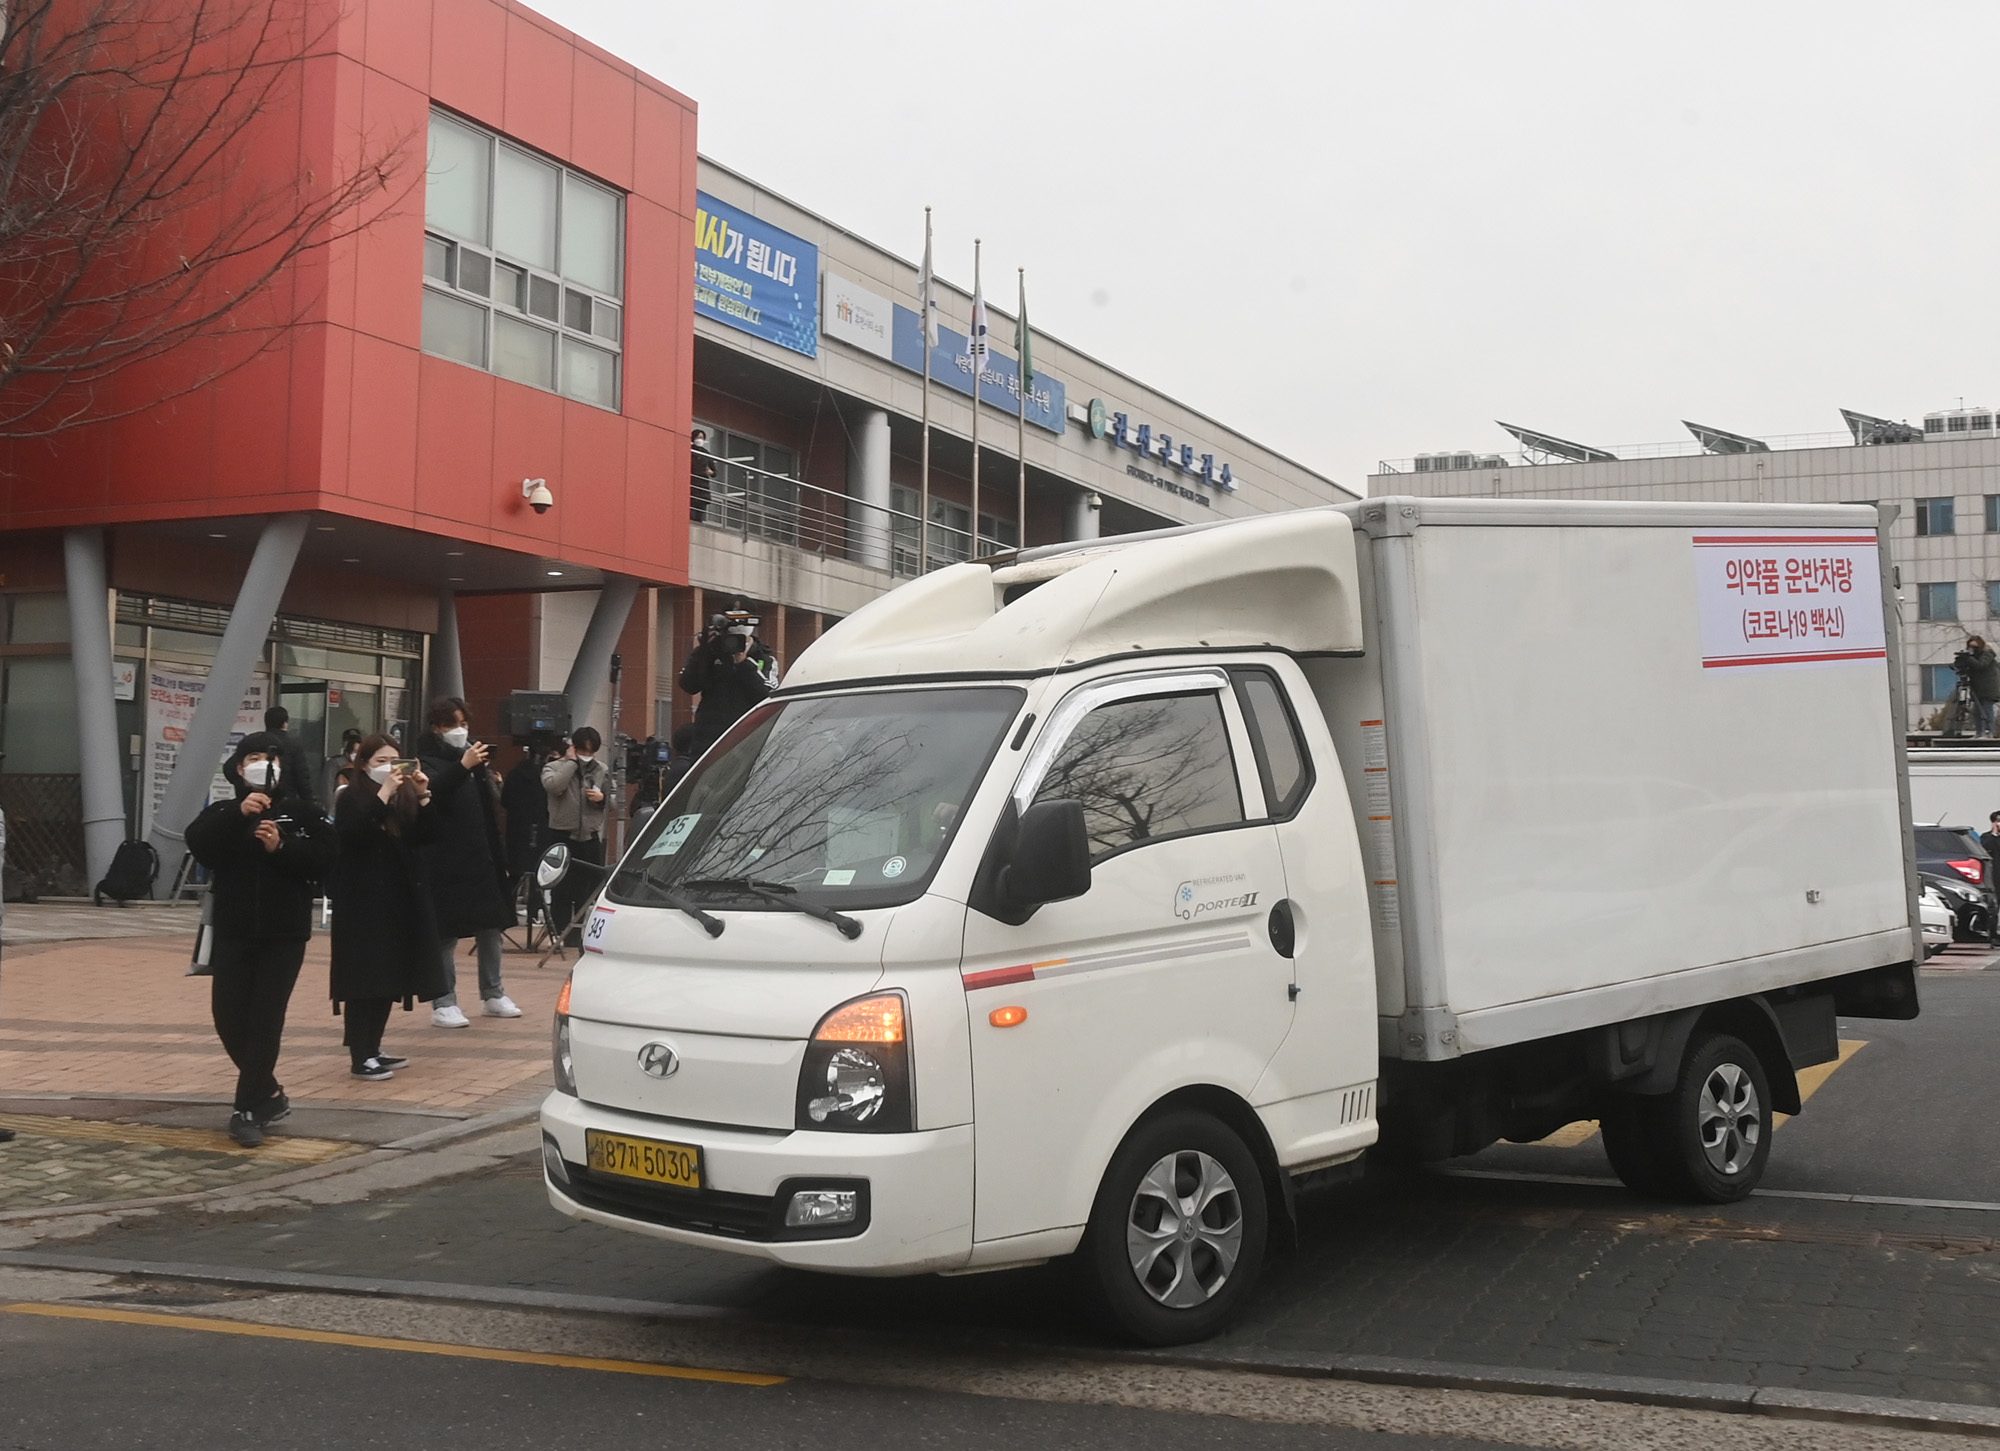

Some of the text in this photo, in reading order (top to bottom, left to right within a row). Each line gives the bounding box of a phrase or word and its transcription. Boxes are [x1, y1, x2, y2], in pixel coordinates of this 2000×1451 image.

[746, 238, 796, 287] 됩니다
[1035, 389, 1050, 413] 수원
[1113, 411, 1233, 492] 권선구보건소
[1726, 557, 1853, 596] 의약품 운반차량
[1742, 605, 1845, 643] (코로나19 백신)
[666, 817, 689, 835] 35
[588, 917, 606, 939] 343
[644, 1146, 691, 1181] 5030
